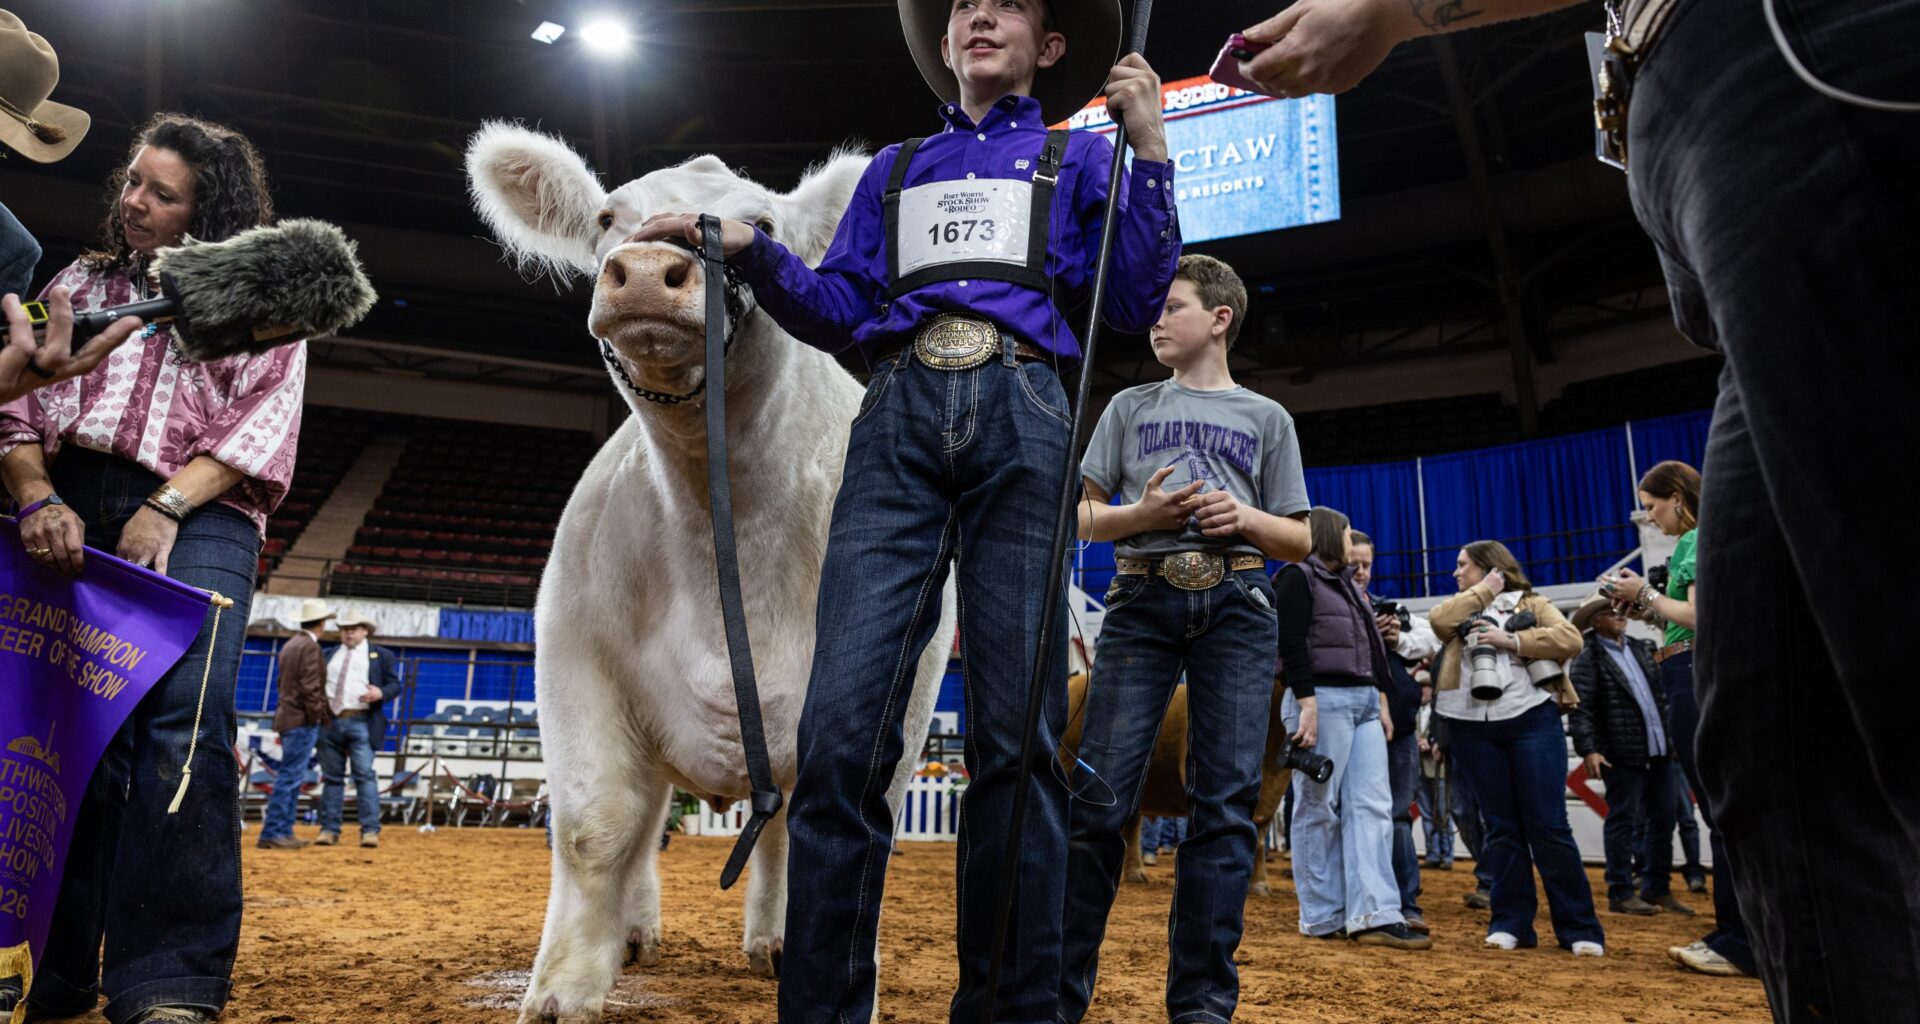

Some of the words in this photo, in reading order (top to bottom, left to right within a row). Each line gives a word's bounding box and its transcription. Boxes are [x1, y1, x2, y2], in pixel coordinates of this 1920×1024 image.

[1164, 82, 1230, 110] RODEO
[1174, 133, 1276, 173] CTAW
[1191, 176, 1264, 198] RESORTS
[937, 199, 963, 208] STOCK
[965, 197, 990, 205] SHOW
[949, 204, 977, 213] RODEO
[928, 219, 995, 246] 1673
[930, 331, 970, 341] NATIONAL
[935, 338, 974, 347] WESTERN
[1137, 420, 1182, 461] TOLAR
[1184, 421, 1258, 474] RATTLERS
[0, 594, 67, 633] GRAND
[68, 616, 147, 671] CHAMPION
[49, 639, 67, 665] OF
[78, 661, 129, 700] SHOW
